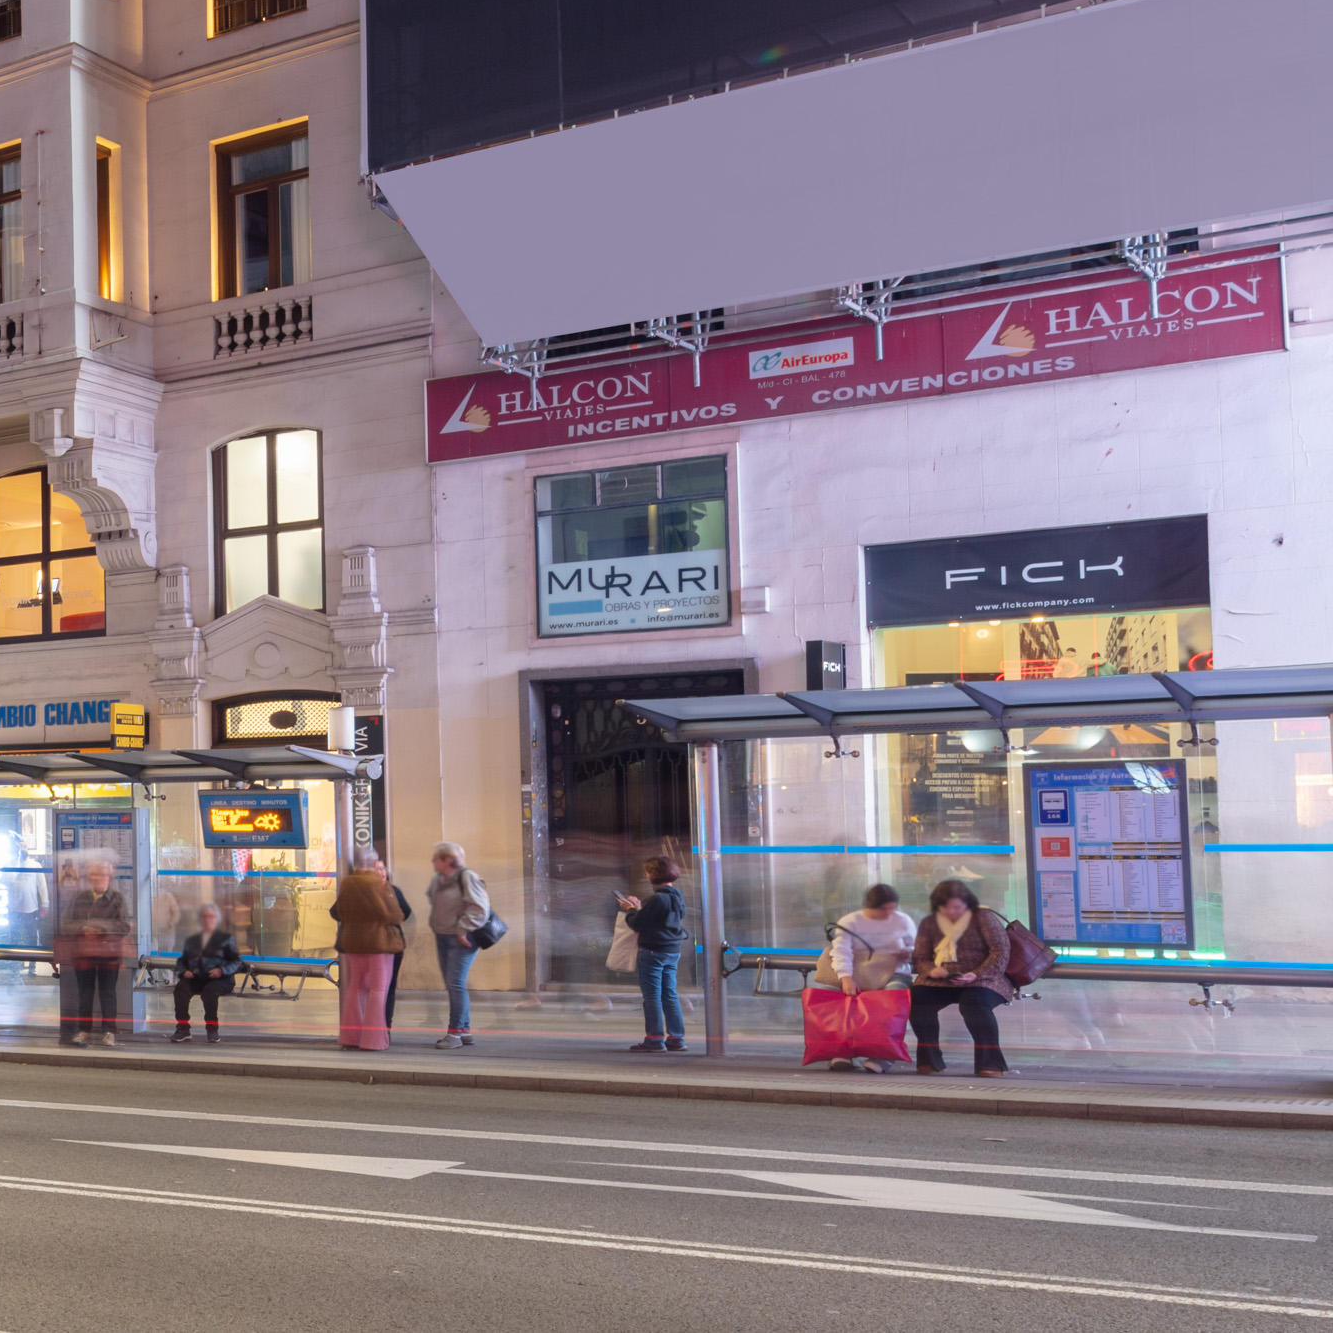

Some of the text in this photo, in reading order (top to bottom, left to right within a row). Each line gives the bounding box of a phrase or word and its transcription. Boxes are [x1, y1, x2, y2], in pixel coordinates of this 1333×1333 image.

[1044, 276, 1262, 336] HALCON
[1109, 316, 1194, 341] VIAJES
[780, 350, 849, 371] AirEuropa
[497, 371, 652, 416] HALCON
[567, 355, 1076, 438] INCENTIVOS Y CONVENCIONES
[544, 403, 605, 422] VIAJES
[547, 564, 719, 599] MURARI
[945, 555, 1124, 590] FICK
[605, 595, 720, 613] OBRAS Y PROYECTOS
[975, 596, 1095, 611] www.fickcompany.com
[549, 611, 720, 630] www.murari.es info@murari.es
[44, 699, 121, 726] CHANG
[355, 726, 368, 752] VIA
